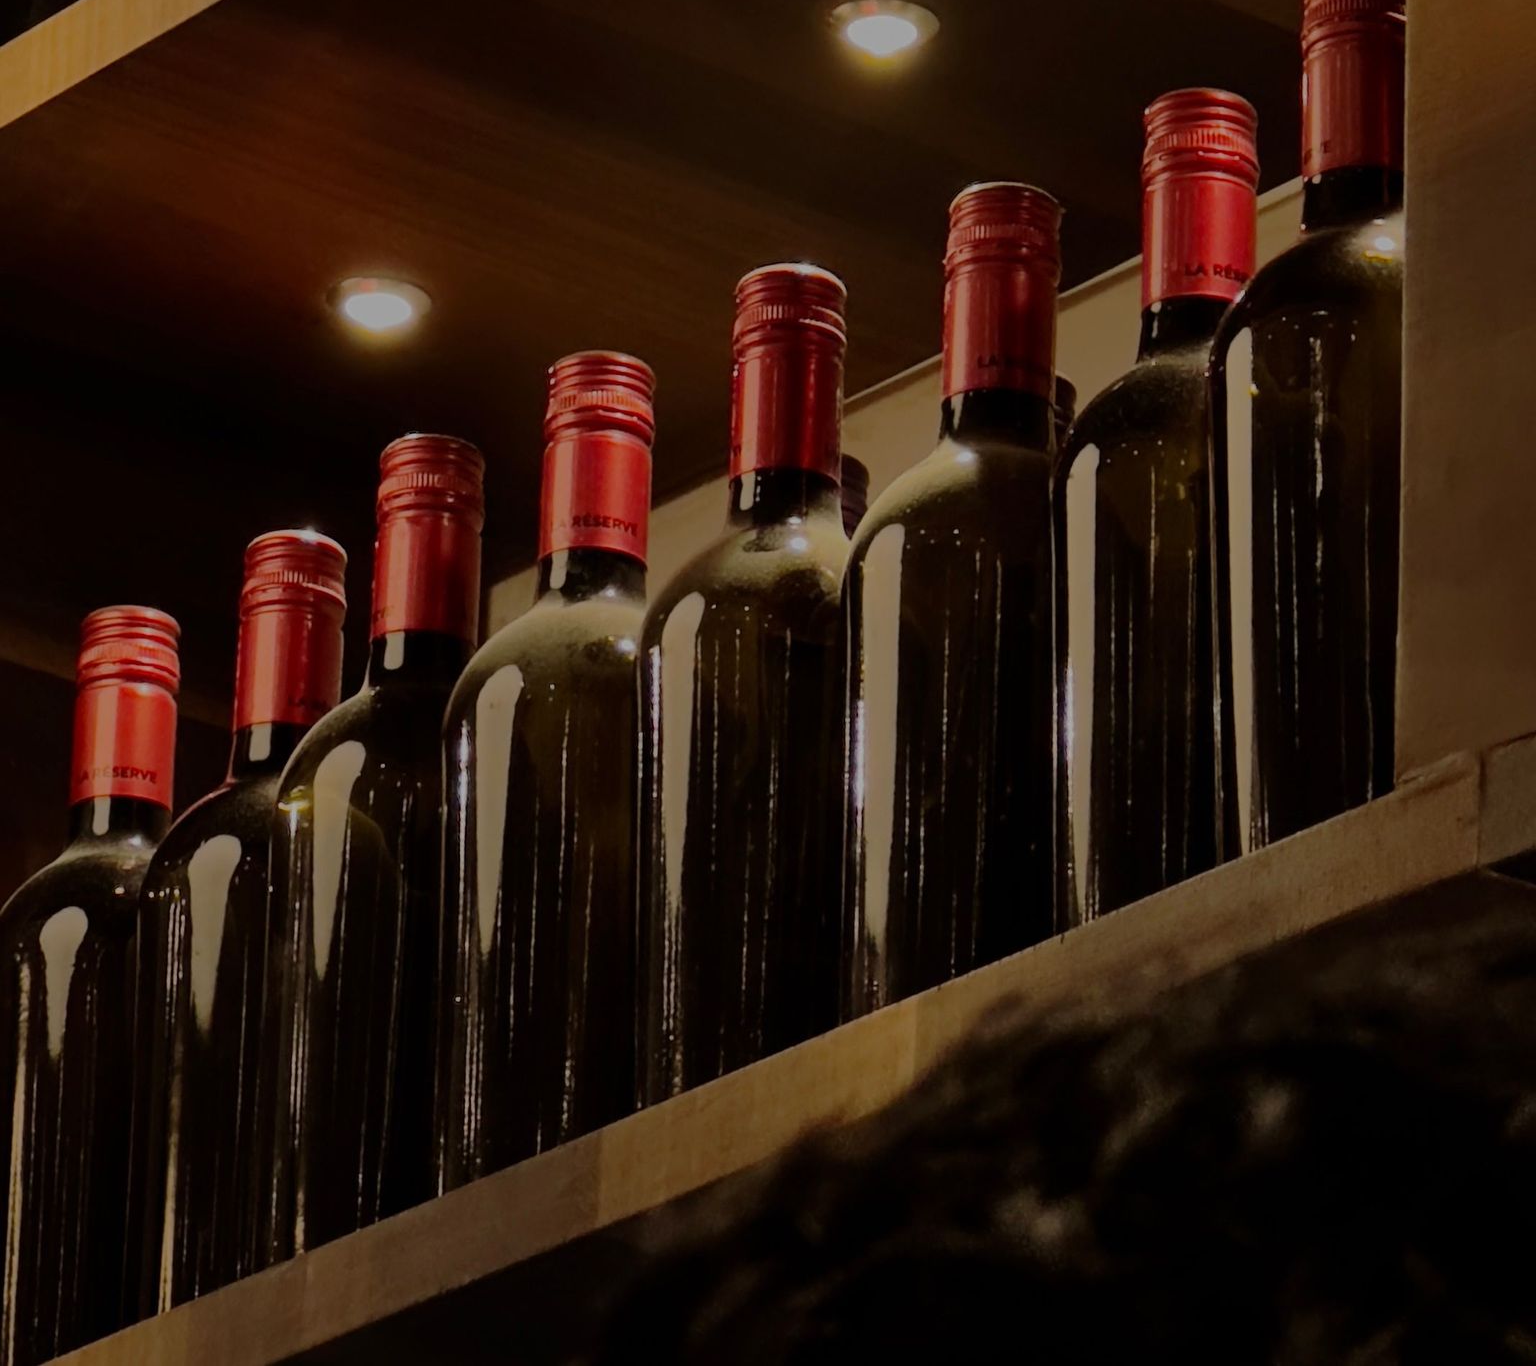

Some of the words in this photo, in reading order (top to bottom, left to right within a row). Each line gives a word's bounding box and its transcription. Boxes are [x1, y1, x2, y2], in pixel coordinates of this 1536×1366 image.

[1184, 263, 1208, 277] LA
[571, 510, 638, 537] RÉSERVE
[91, 764, 158, 785] RÉSERVE
